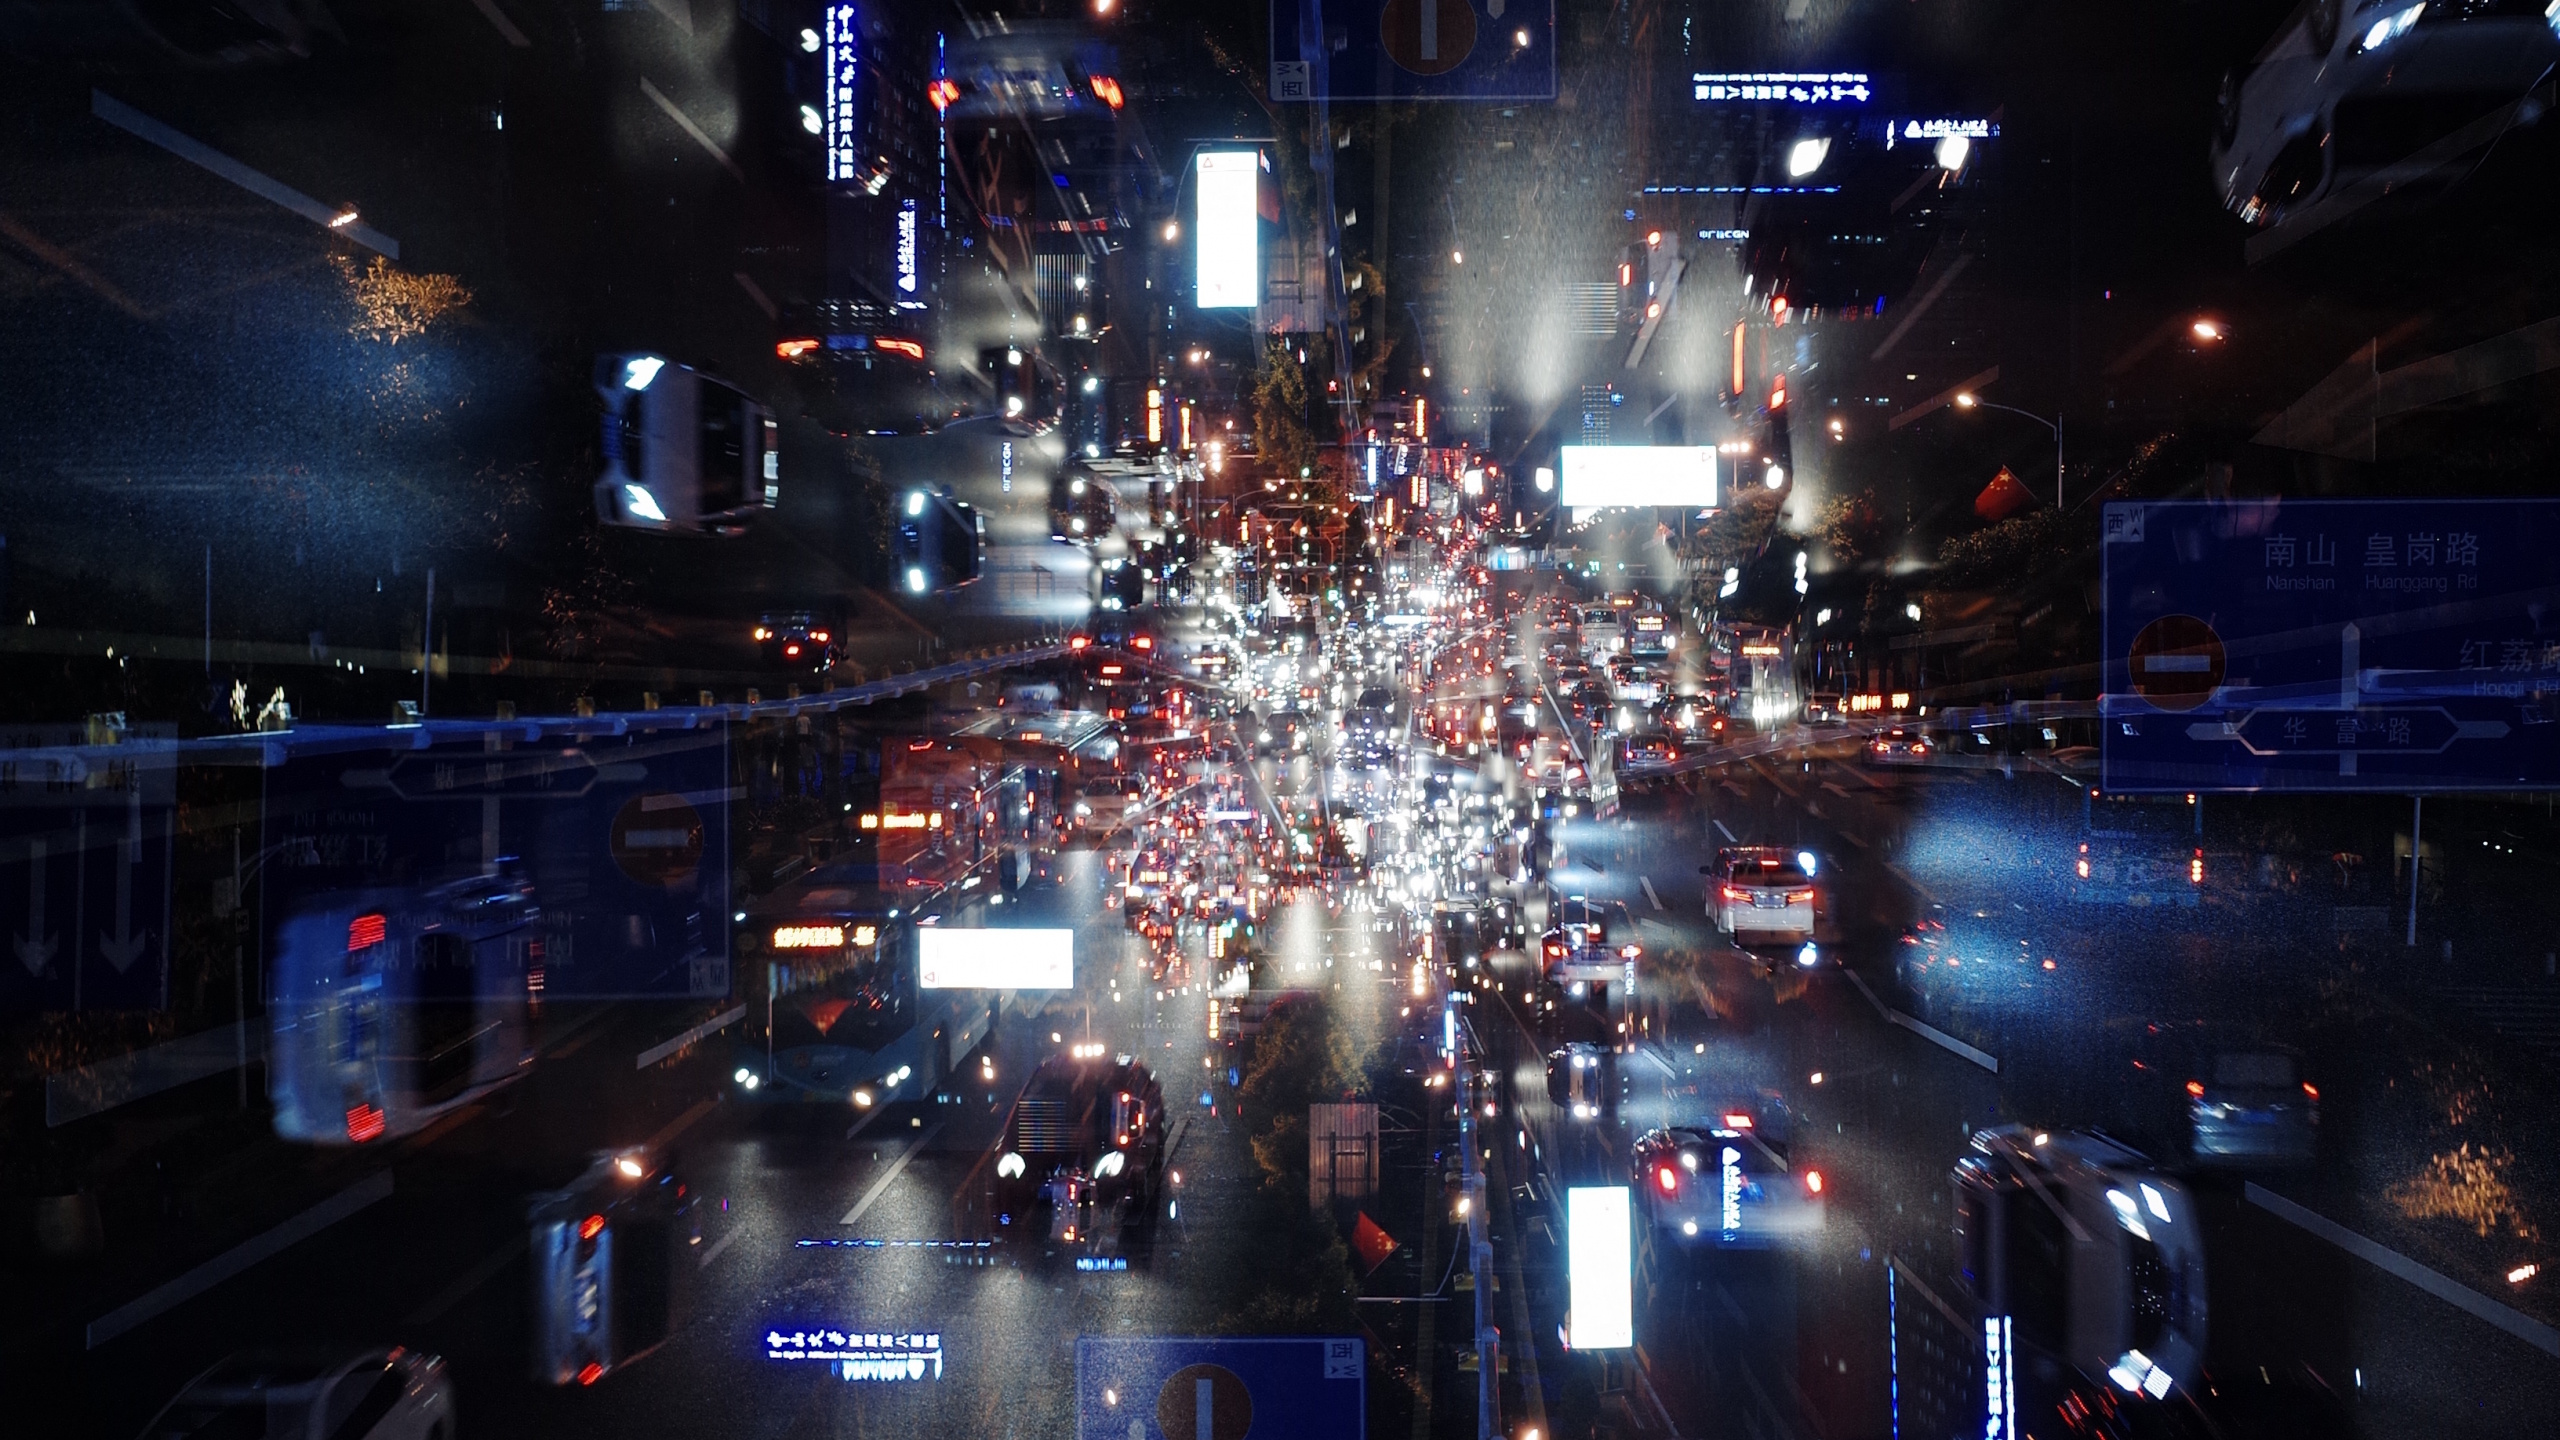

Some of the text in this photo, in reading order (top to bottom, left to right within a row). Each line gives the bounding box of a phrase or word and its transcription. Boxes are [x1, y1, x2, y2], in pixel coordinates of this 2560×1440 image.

[1282, 81, 1302, 97] 西
[2107, 508, 2143, 535] 西 W
[2264, 532, 2480, 567] 南山 皇岗路
[2266, 574, 2478, 593] Nanshan Huanggang Rd
[2473, 680, 2525, 698] Hongli
[2284, 716, 2411, 745] 华富路
